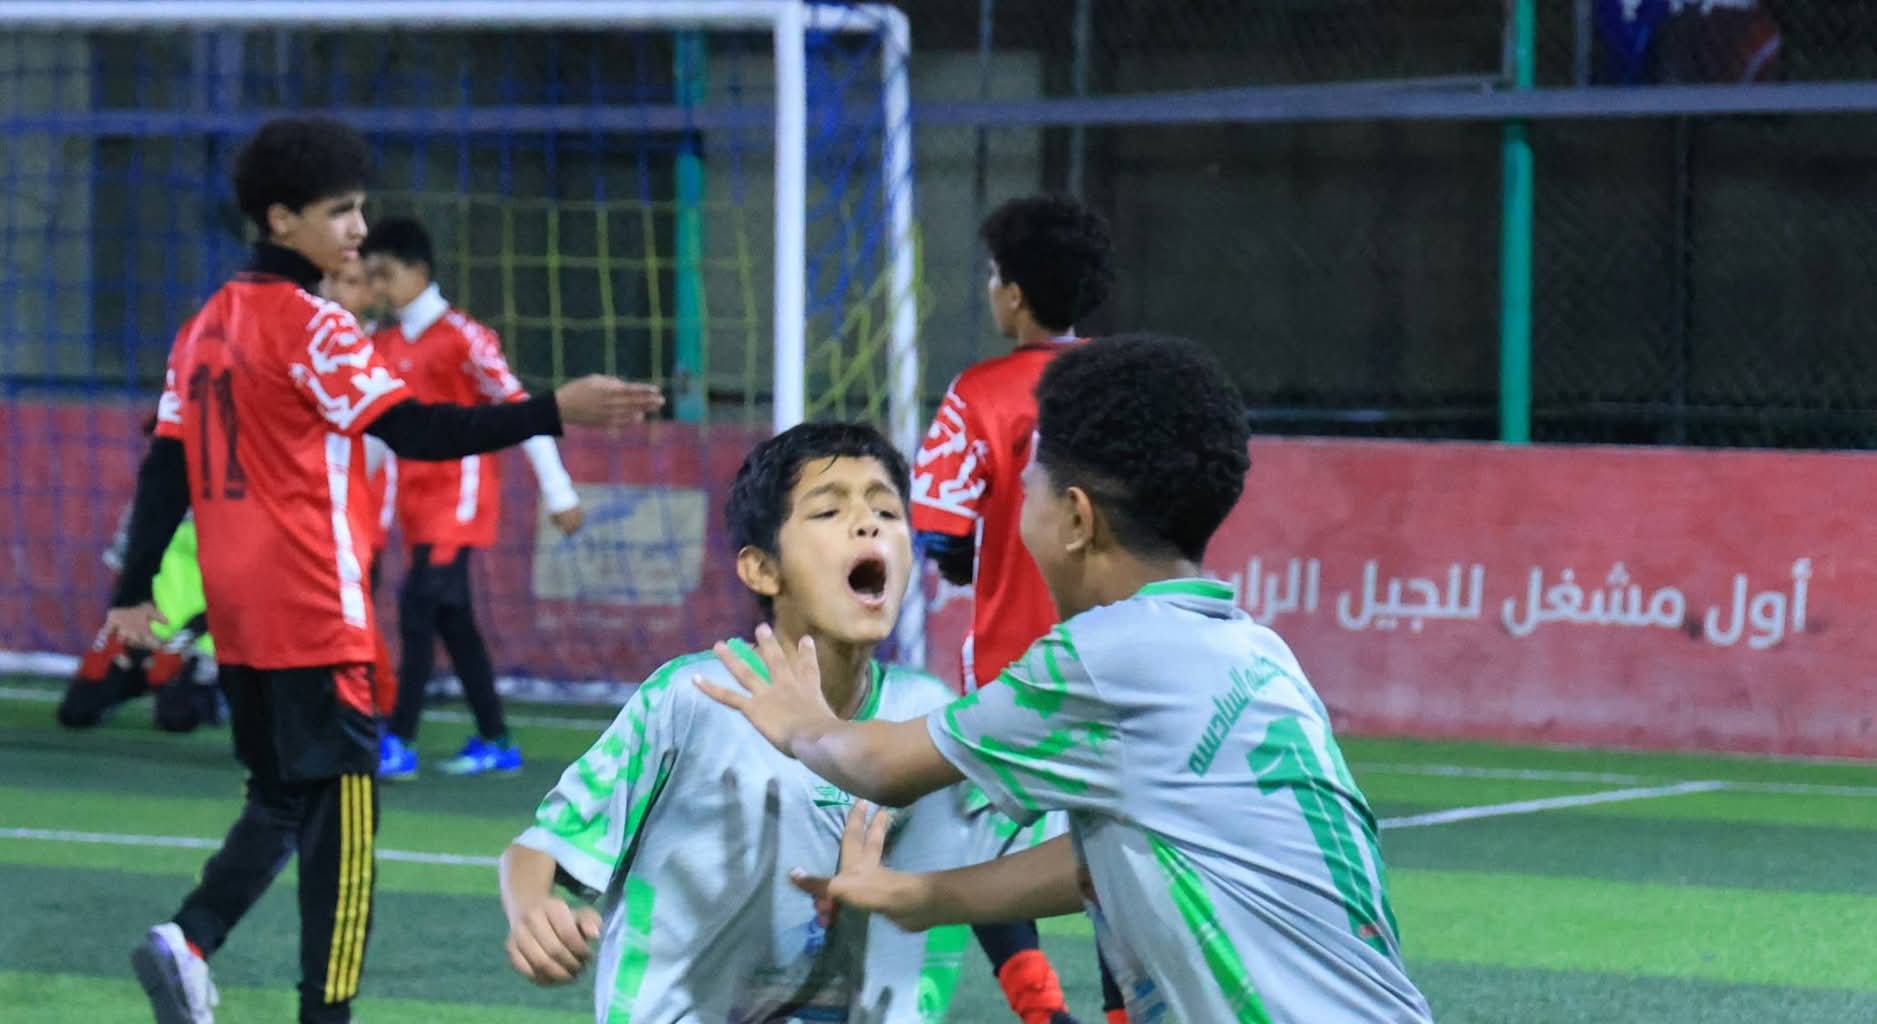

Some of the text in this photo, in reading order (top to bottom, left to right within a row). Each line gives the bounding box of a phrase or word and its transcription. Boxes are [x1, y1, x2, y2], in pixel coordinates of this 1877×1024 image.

[1337, 559, 1487, 633] للجيل
[1501, 561, 1687, 637] مشغل
[1704, 558, 1809, 649] أول
